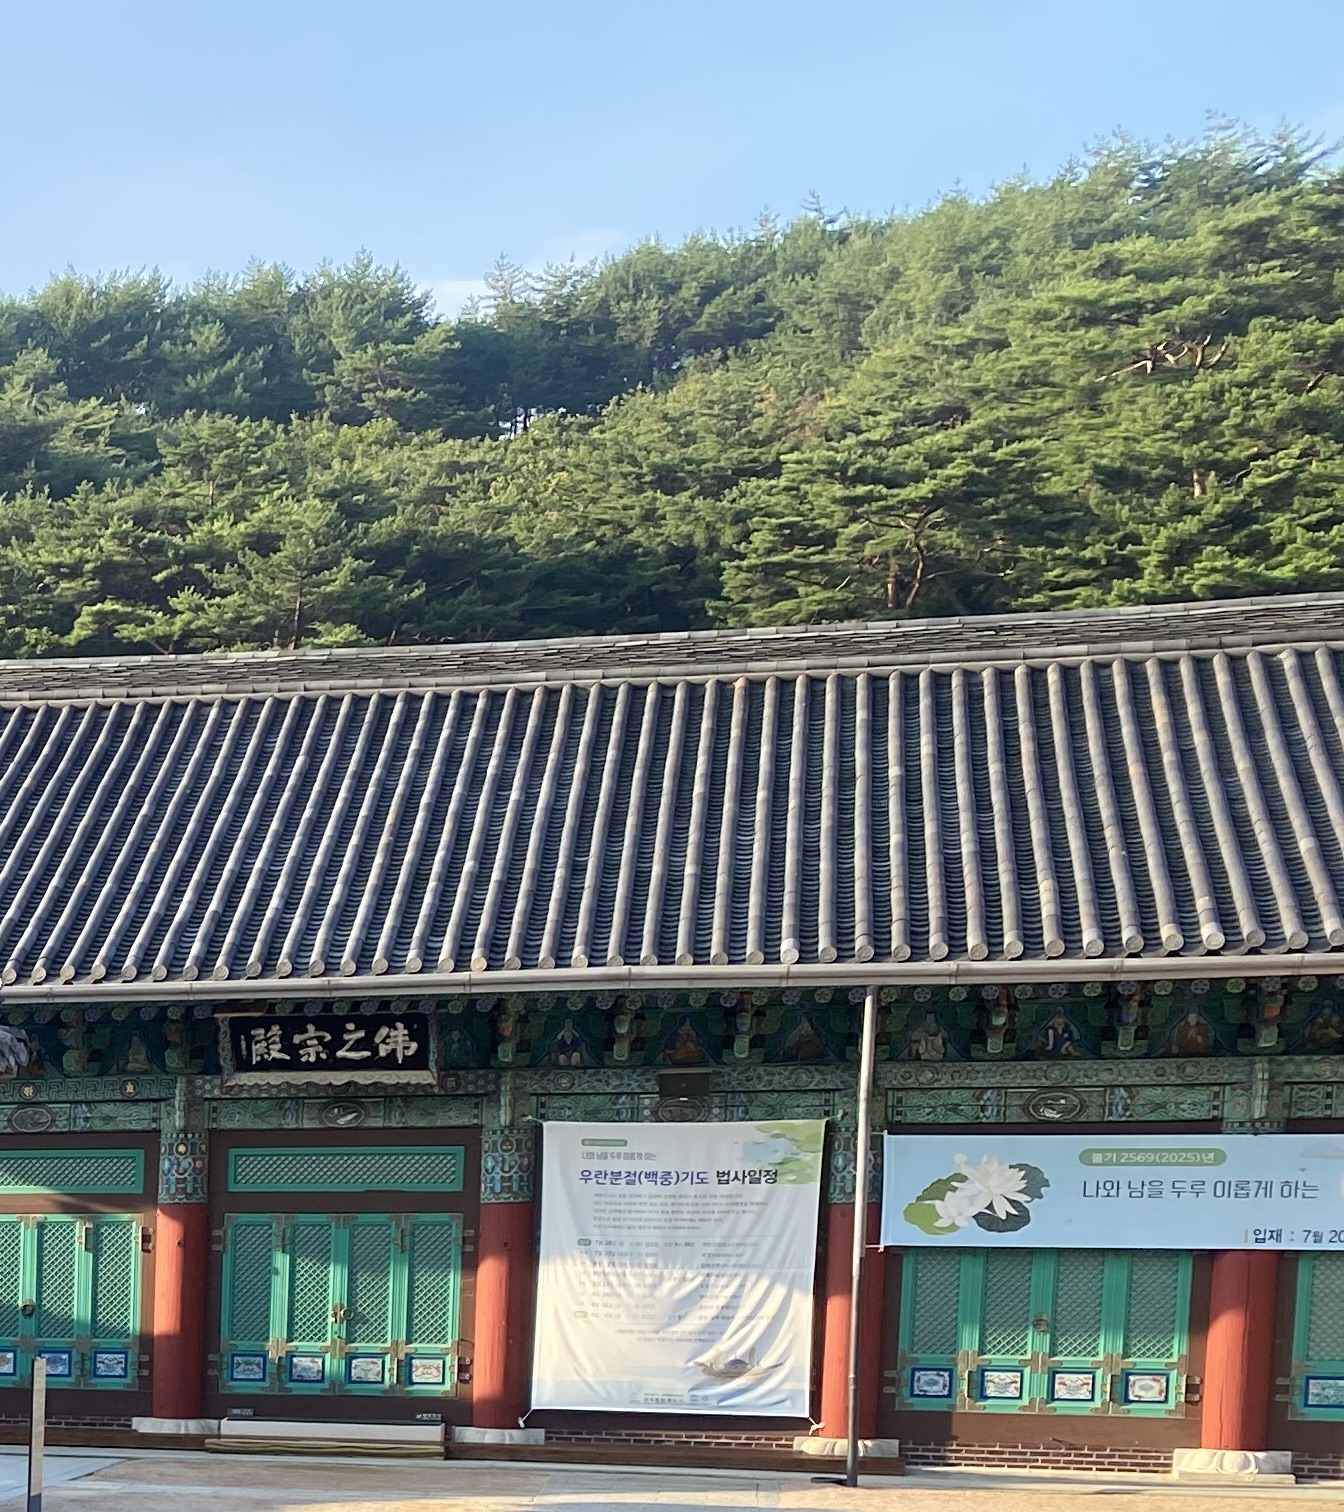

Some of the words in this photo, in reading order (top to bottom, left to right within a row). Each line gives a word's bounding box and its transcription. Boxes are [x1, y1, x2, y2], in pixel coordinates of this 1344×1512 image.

[1091, 1151, 1117, 1164] 불기
[1120, 1151, 1216, 1164] 2569(2025)년
[579, 1169, 710, 1186] 우란분절(백중)기도
[716, 1169, 778, 1186] 법사일정
[1082, 1179, 1122, 1199] 나와
[1127, 1180, 1165, 1199] 남을
[1170, 1180, 1207, 1198] 두루
[1213, 1180, 1274, 1200] 이롭게
[1279, 1180, 1320, 1199] 하는
[1253, 1229, 1283, 1243] 입재
[1303, 1230, 1324, 1244] 7월
